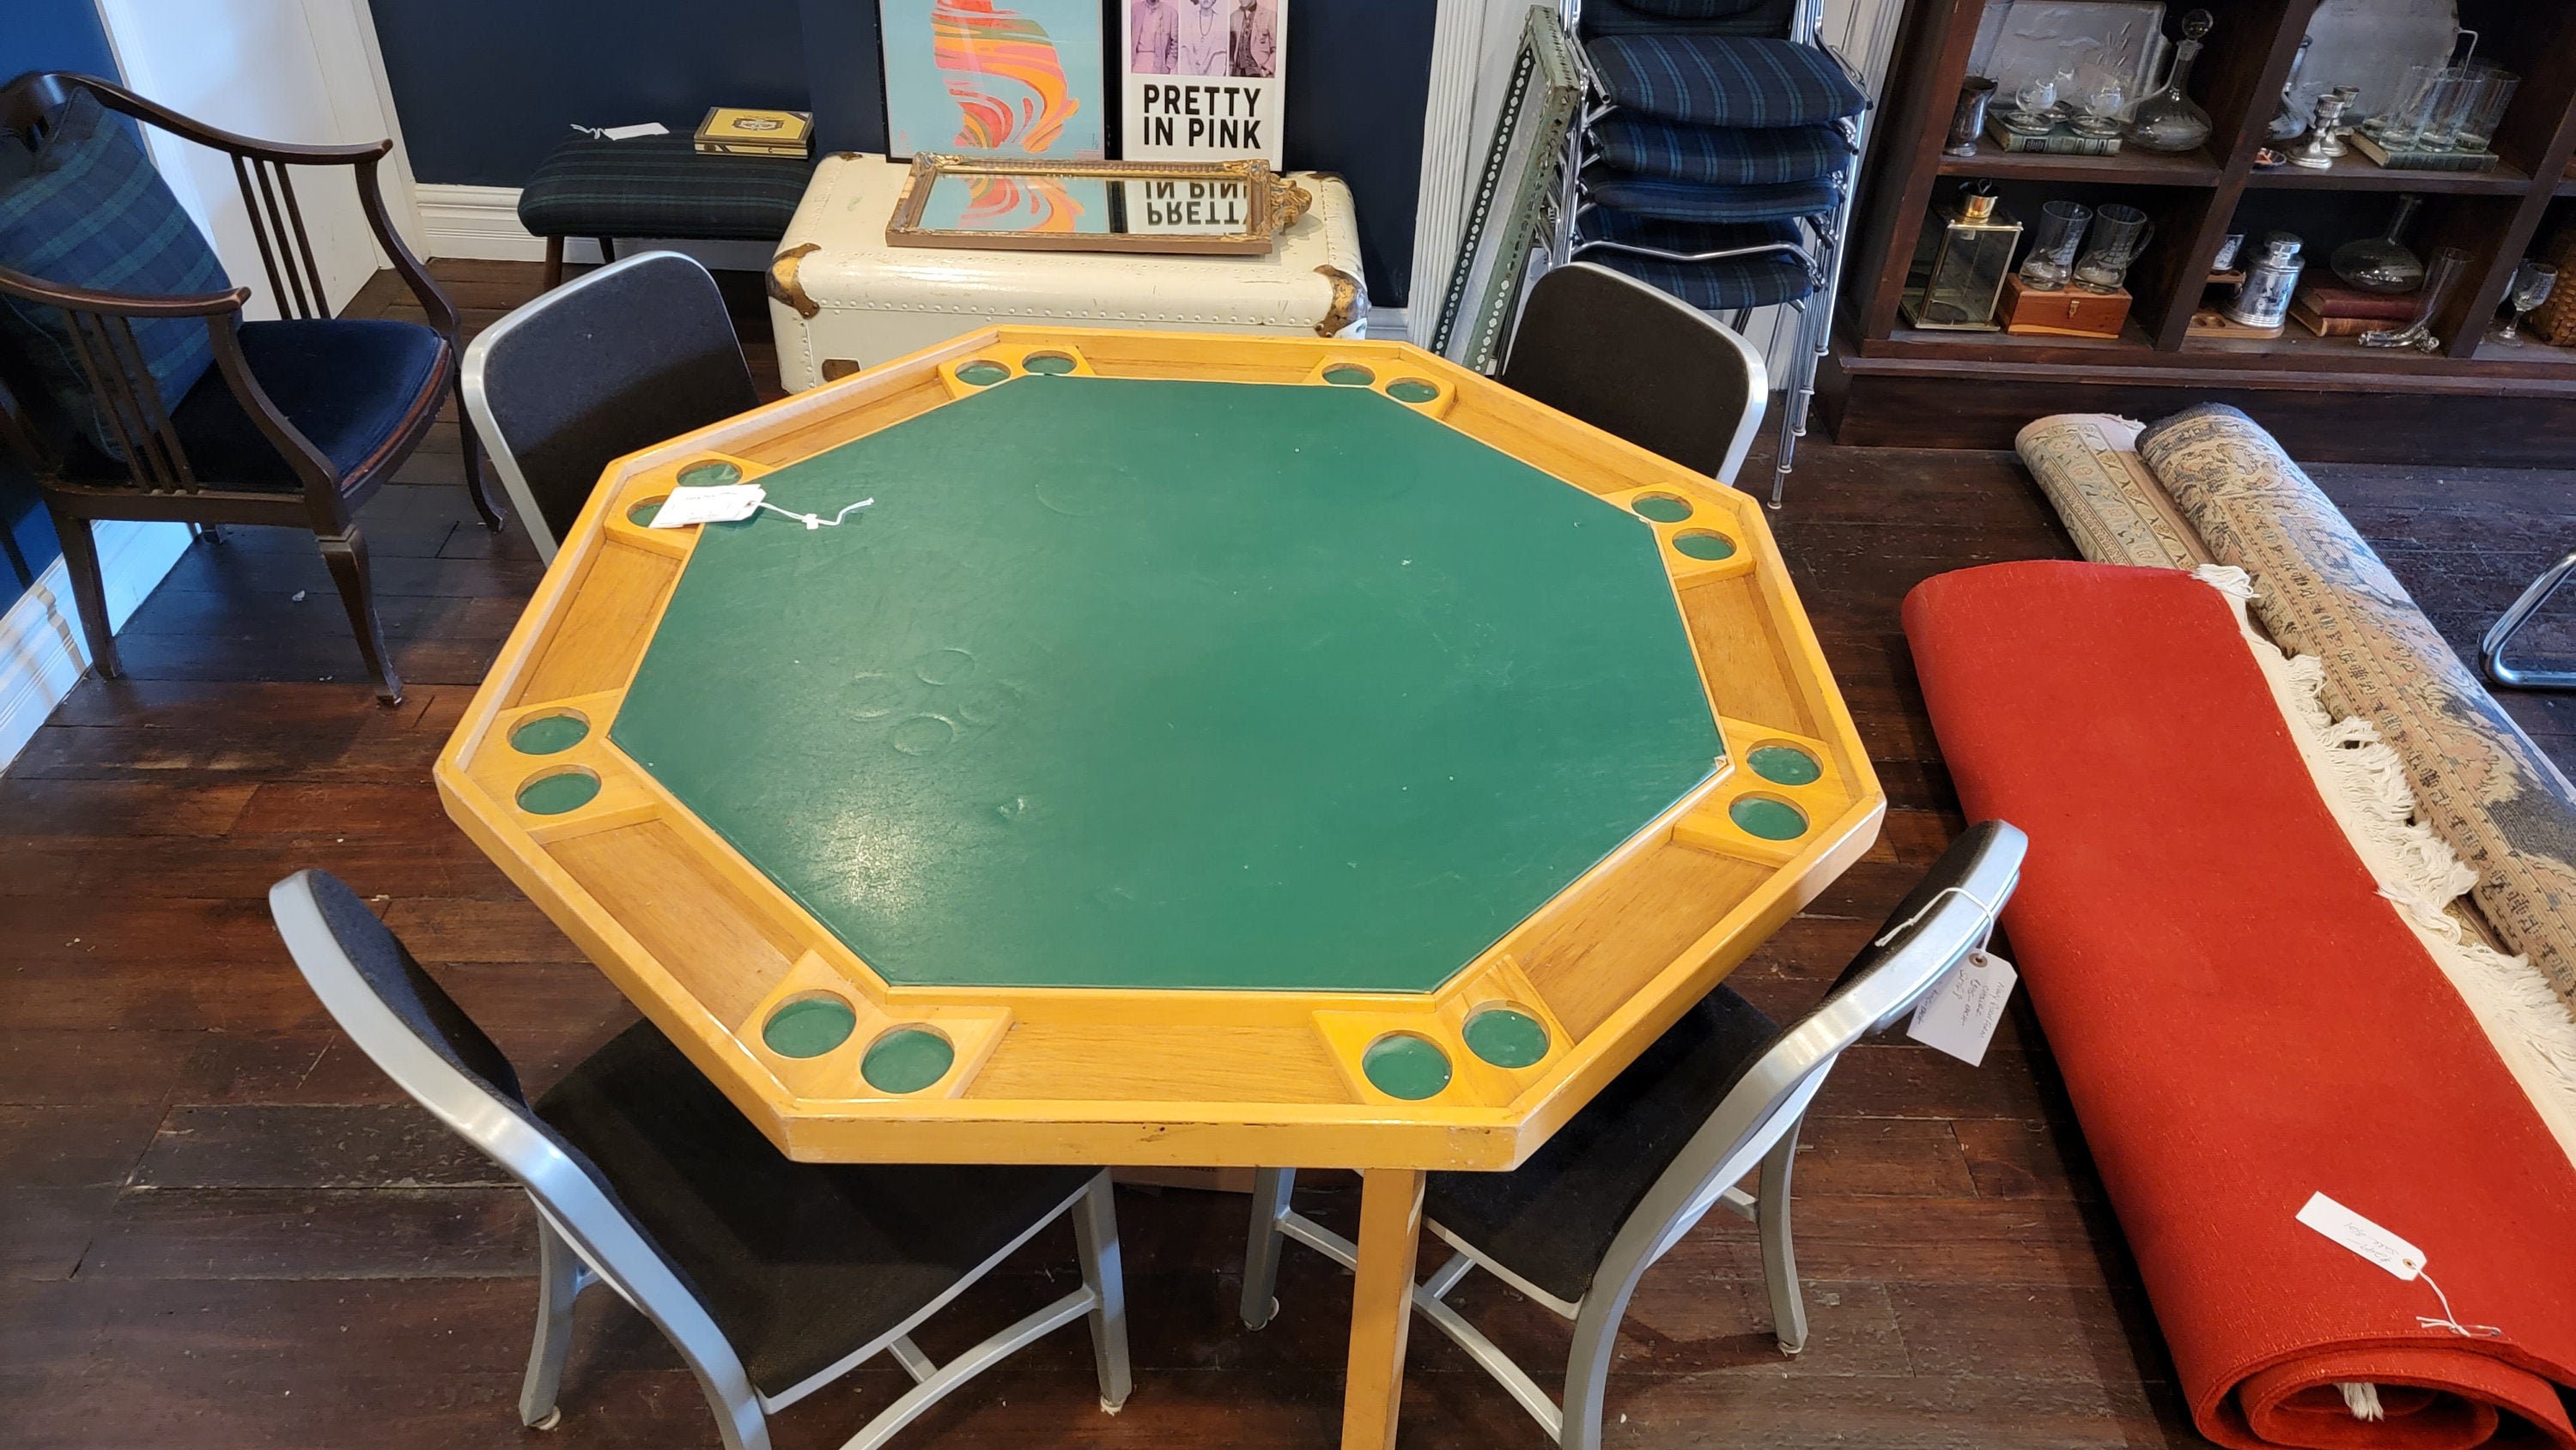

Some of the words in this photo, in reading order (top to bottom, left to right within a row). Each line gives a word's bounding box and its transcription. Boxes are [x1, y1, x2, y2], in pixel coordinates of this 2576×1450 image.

[1144, 84, 1261, 117] PRETTY
[1144, 117, 1173, 146] IN
[1188, 118, 1261, 149] PINK
